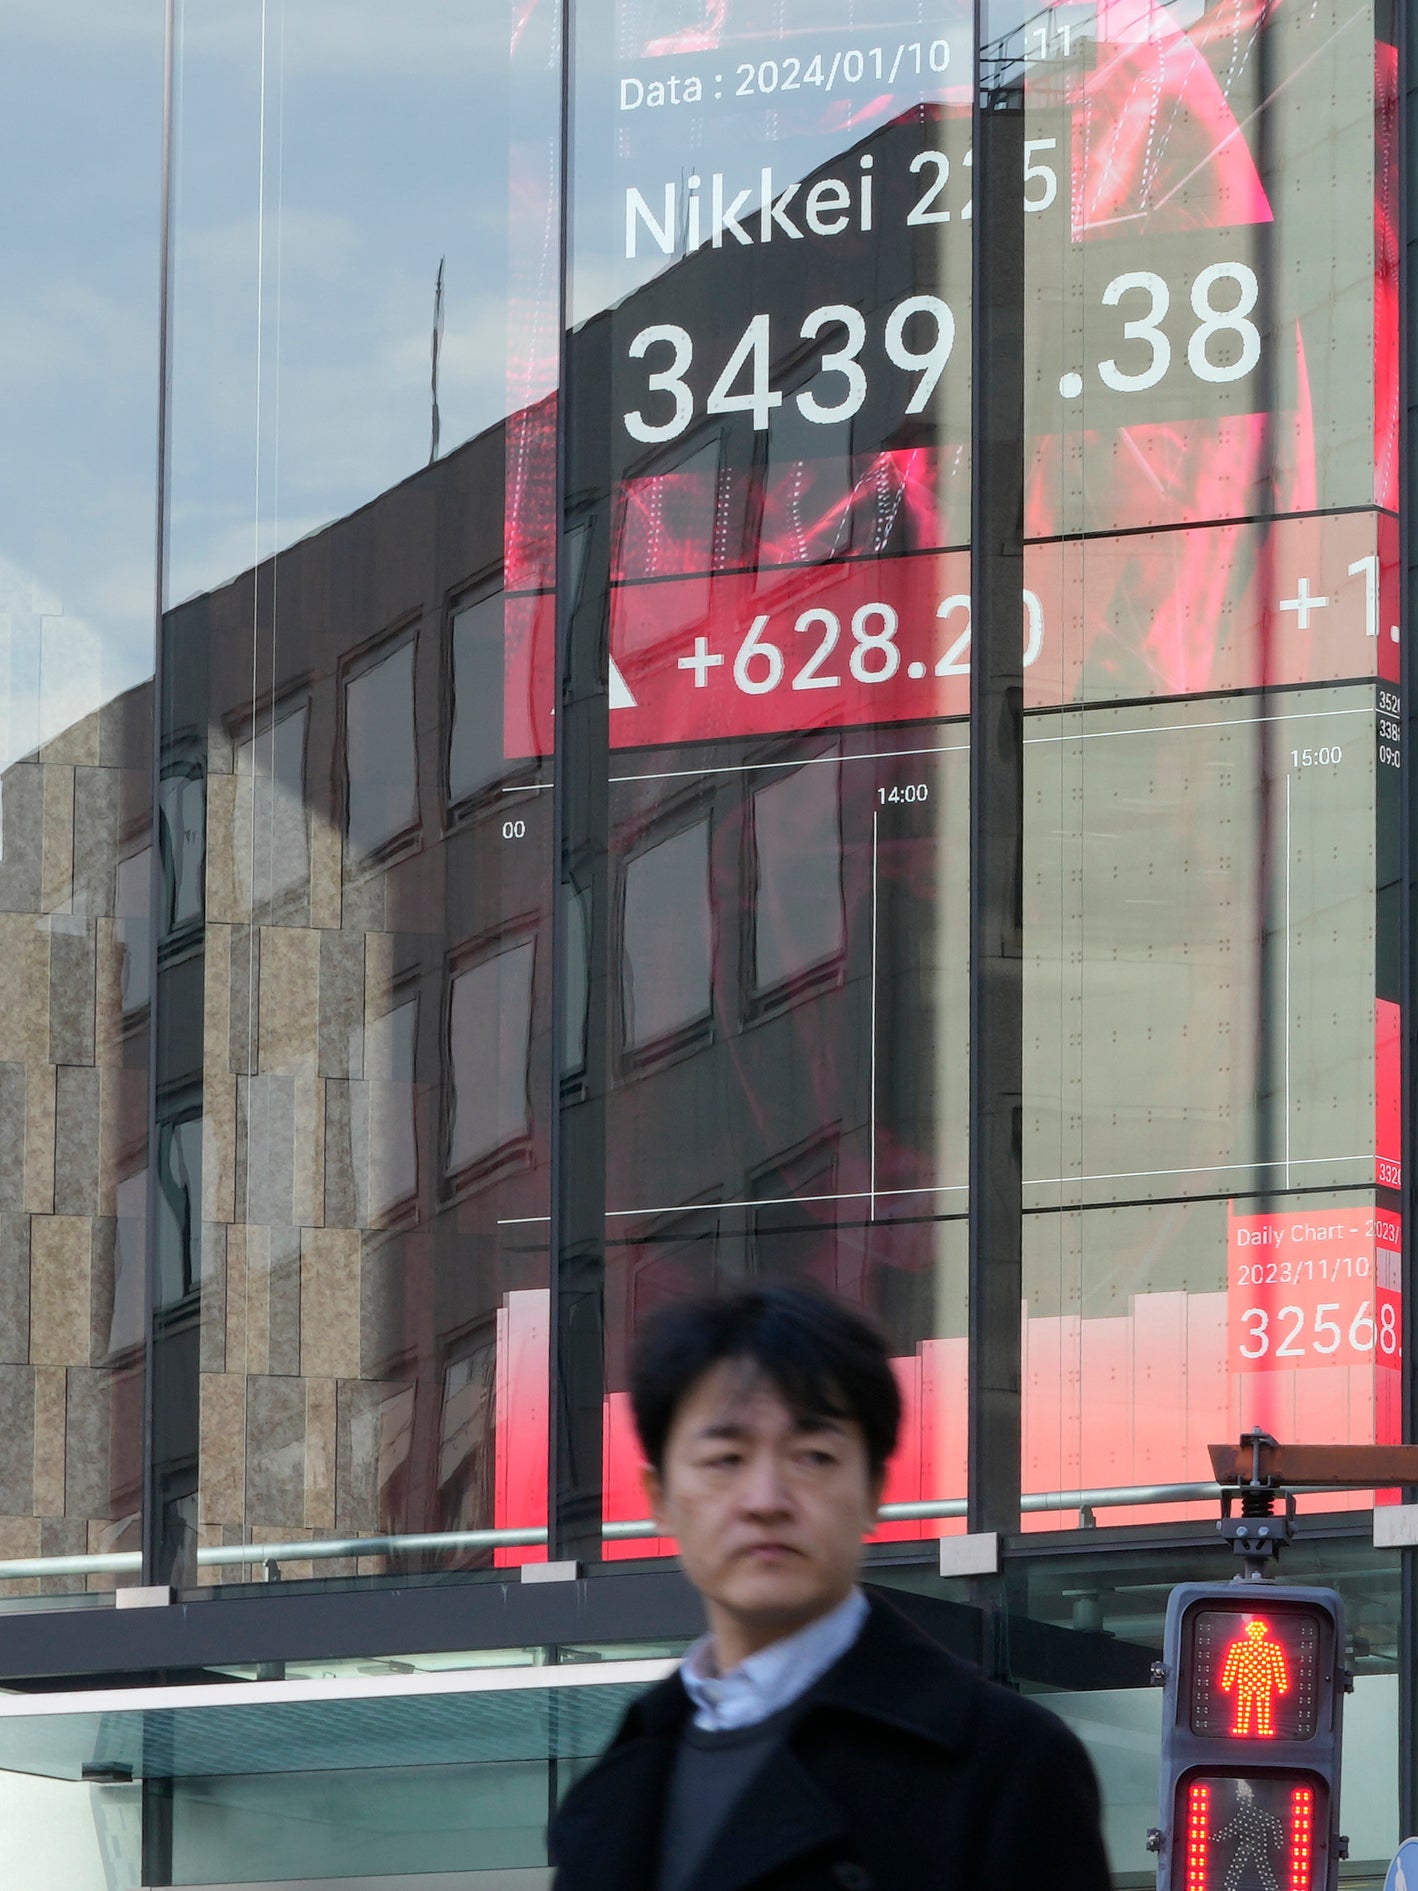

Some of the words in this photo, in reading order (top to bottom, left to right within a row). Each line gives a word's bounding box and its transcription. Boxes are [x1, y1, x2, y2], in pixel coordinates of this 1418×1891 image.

[620, 79, 702, 111] Data
[714, 74, 722, 98] :
[735, 39, 951, 96] 2024/01/10
[625, 154, 874, 259] Nikkei
[907, 138, 1057, 226] 25
[623, 262, 1261, 443] 3439.38
[1291, 746, 1343, 768] 15:00
[878, 783, 928, 805] 14:00
[503, 820, 526, 839] 00
[1237, 1225, 1284, 1248] Daily
[1290, 1222, 1345, 1243] Chart
[1364, 1219, 1402, 1245] 2023/
[1237, 1256, 1369, 1286] 2023/11/10
